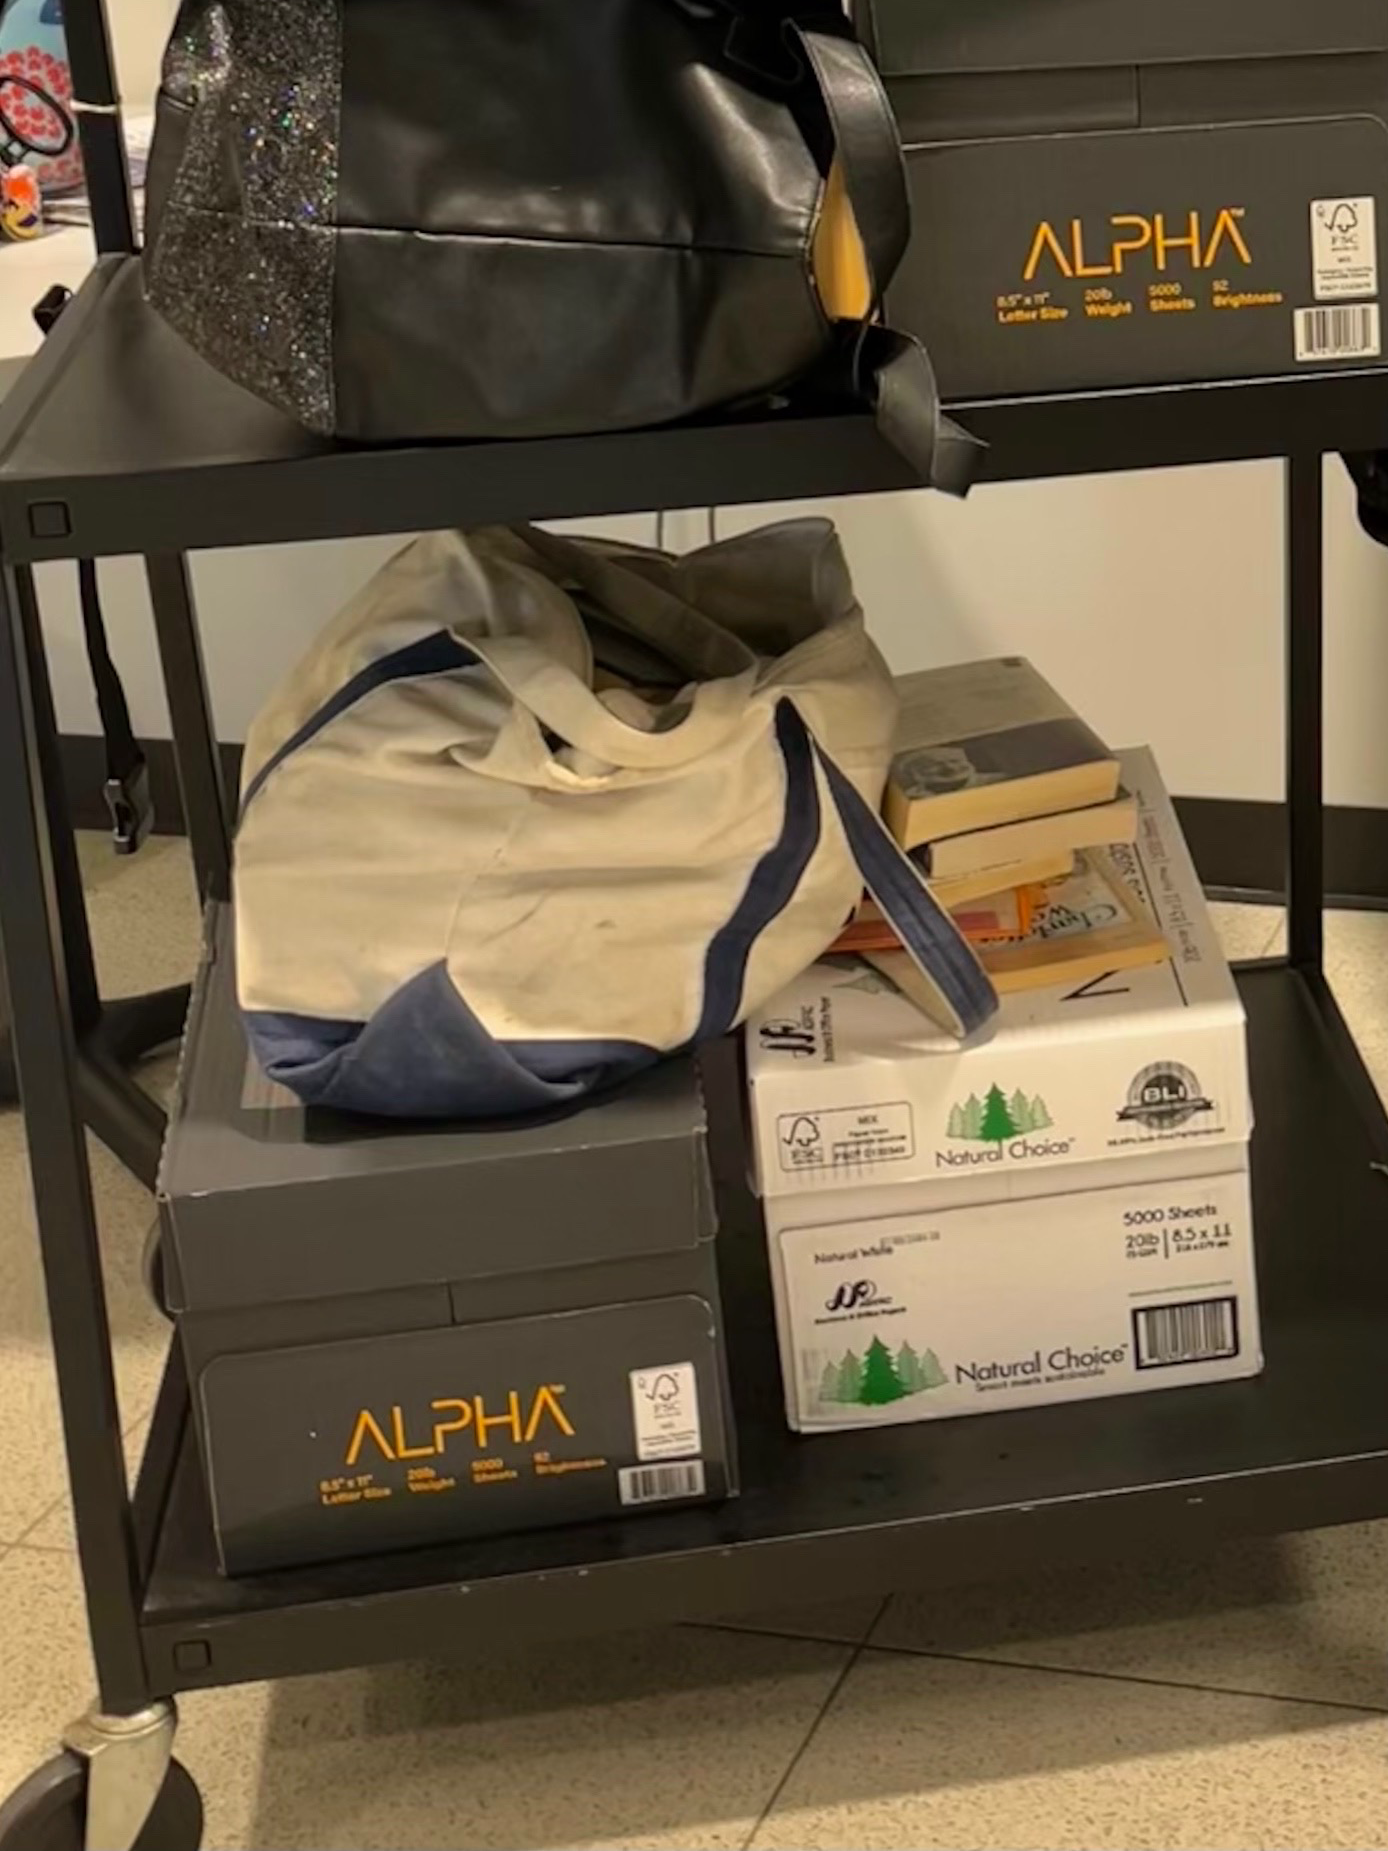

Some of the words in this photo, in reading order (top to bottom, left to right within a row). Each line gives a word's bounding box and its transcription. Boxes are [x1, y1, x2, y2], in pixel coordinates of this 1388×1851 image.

[1022, 207, 1252, 281] ALPHA
[1086, 302, 1132, 317] Weight
[1143, 1084, 1185, 1104] BLI
[935, 1140, 1001, 1168] Natural
[1008, 1139, 1070, 1159] Choice
[1123, 1208, 1165, 1227] 5000
[1167, 1203, 1218, 1221] Sheets
[814, 1249, 858, 1265] Natural
[954, 1350, 1041, 1384] Natural
[1047, 1346, 1125, 1371] Choice
[345, 1385, 576, 1466] ALPHA
